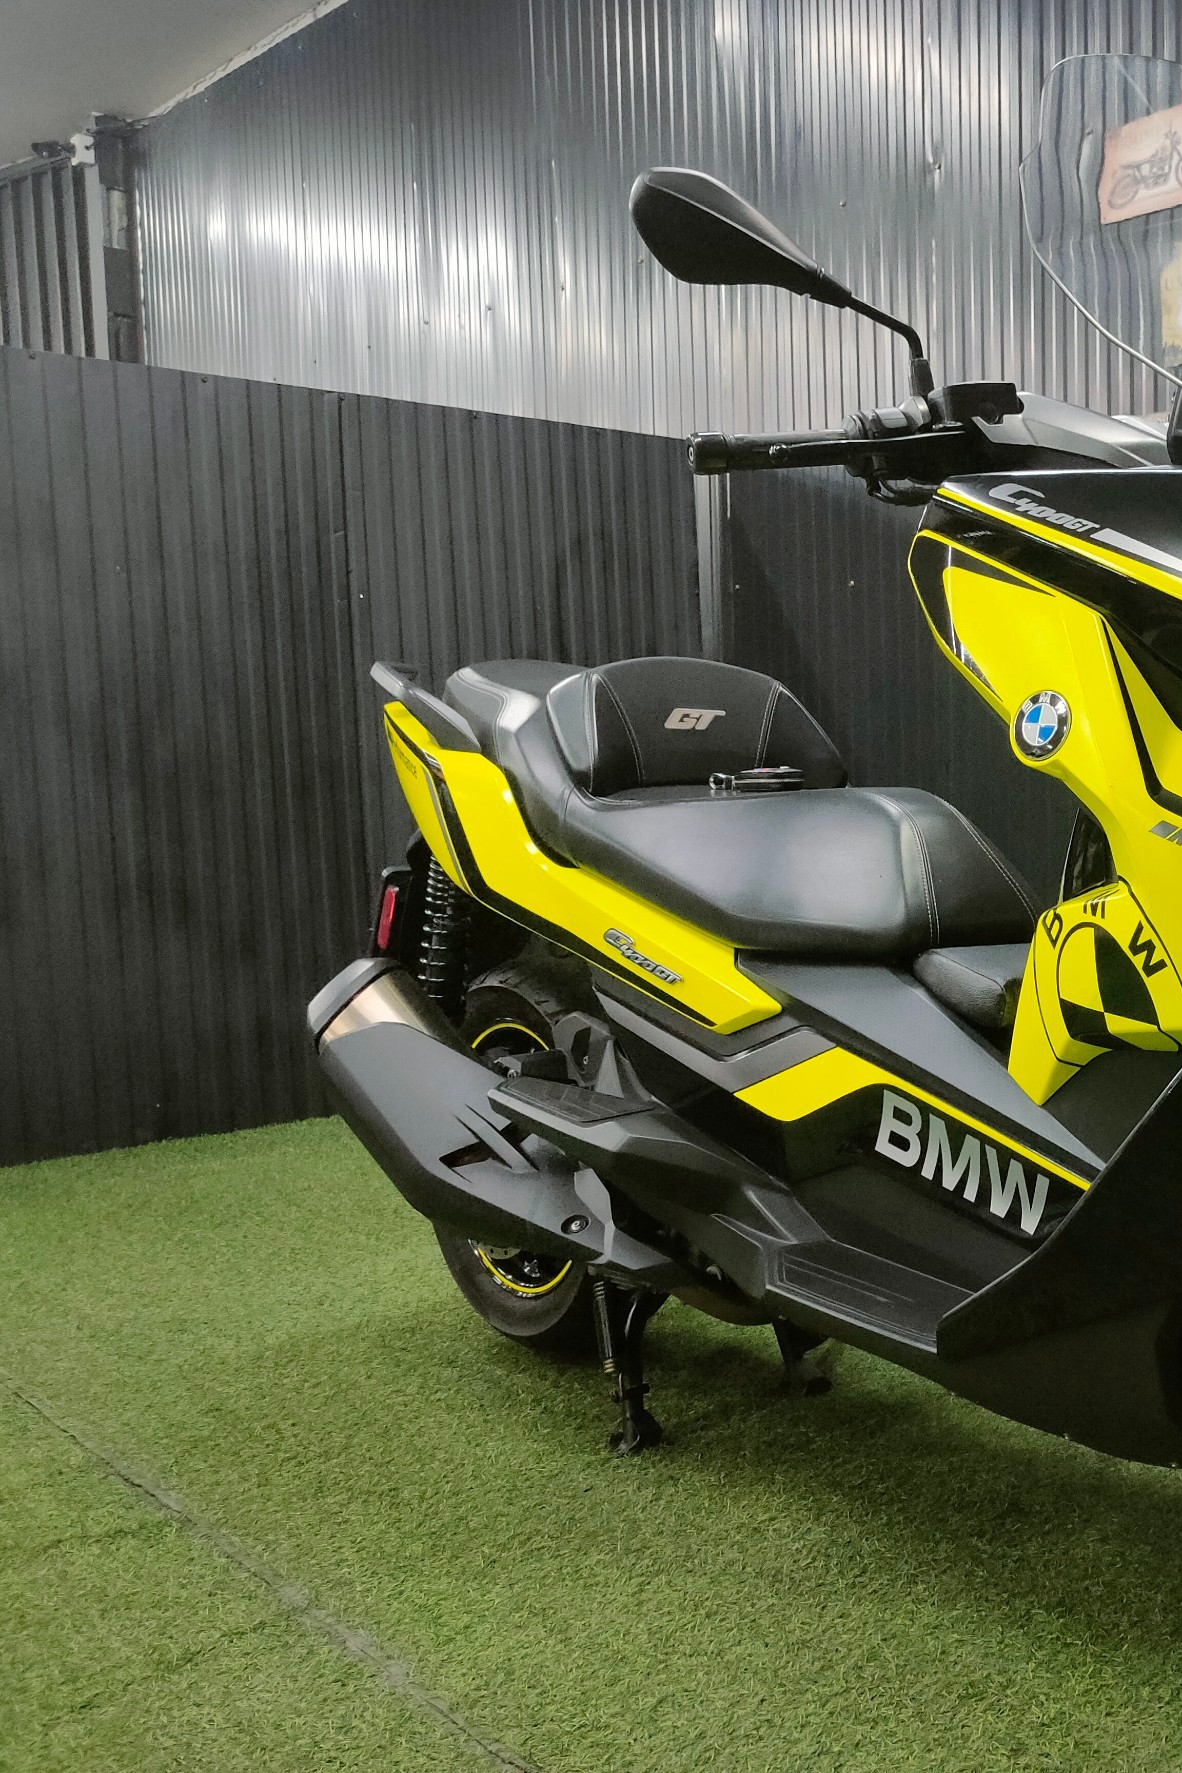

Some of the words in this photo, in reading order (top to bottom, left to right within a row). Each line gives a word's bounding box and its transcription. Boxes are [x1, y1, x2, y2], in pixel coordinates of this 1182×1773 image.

[664, 707, 727, 731] GT
[1042, 889, 1169, 979] BMW
[874, 1088, 1051, 1236] BMW
